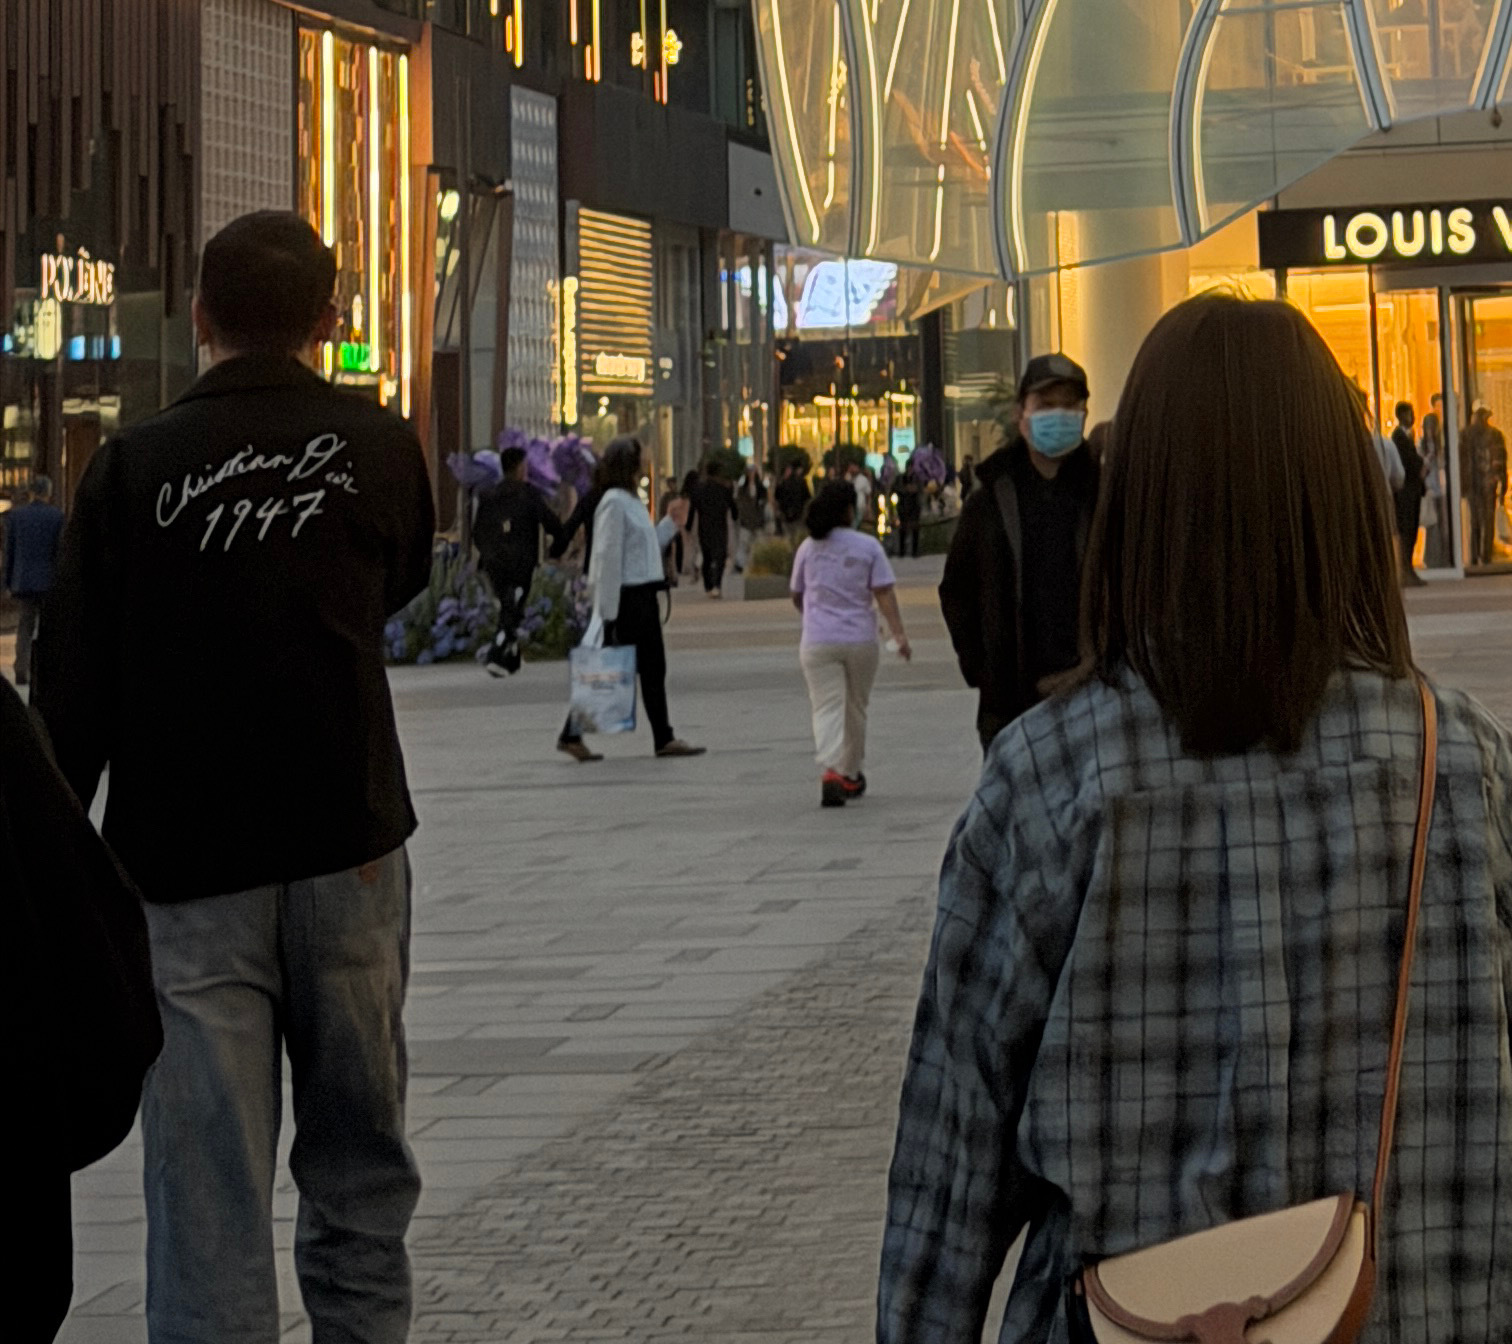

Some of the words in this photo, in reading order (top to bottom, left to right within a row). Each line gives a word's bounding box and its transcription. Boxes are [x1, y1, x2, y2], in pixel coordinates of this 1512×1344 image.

[1323, 207, 1476, 260] LOUIS
[156, 444, 294, 528] Christian
[287, 432, 359, 495] Dior
[199, 488, 327, 553] 1947
